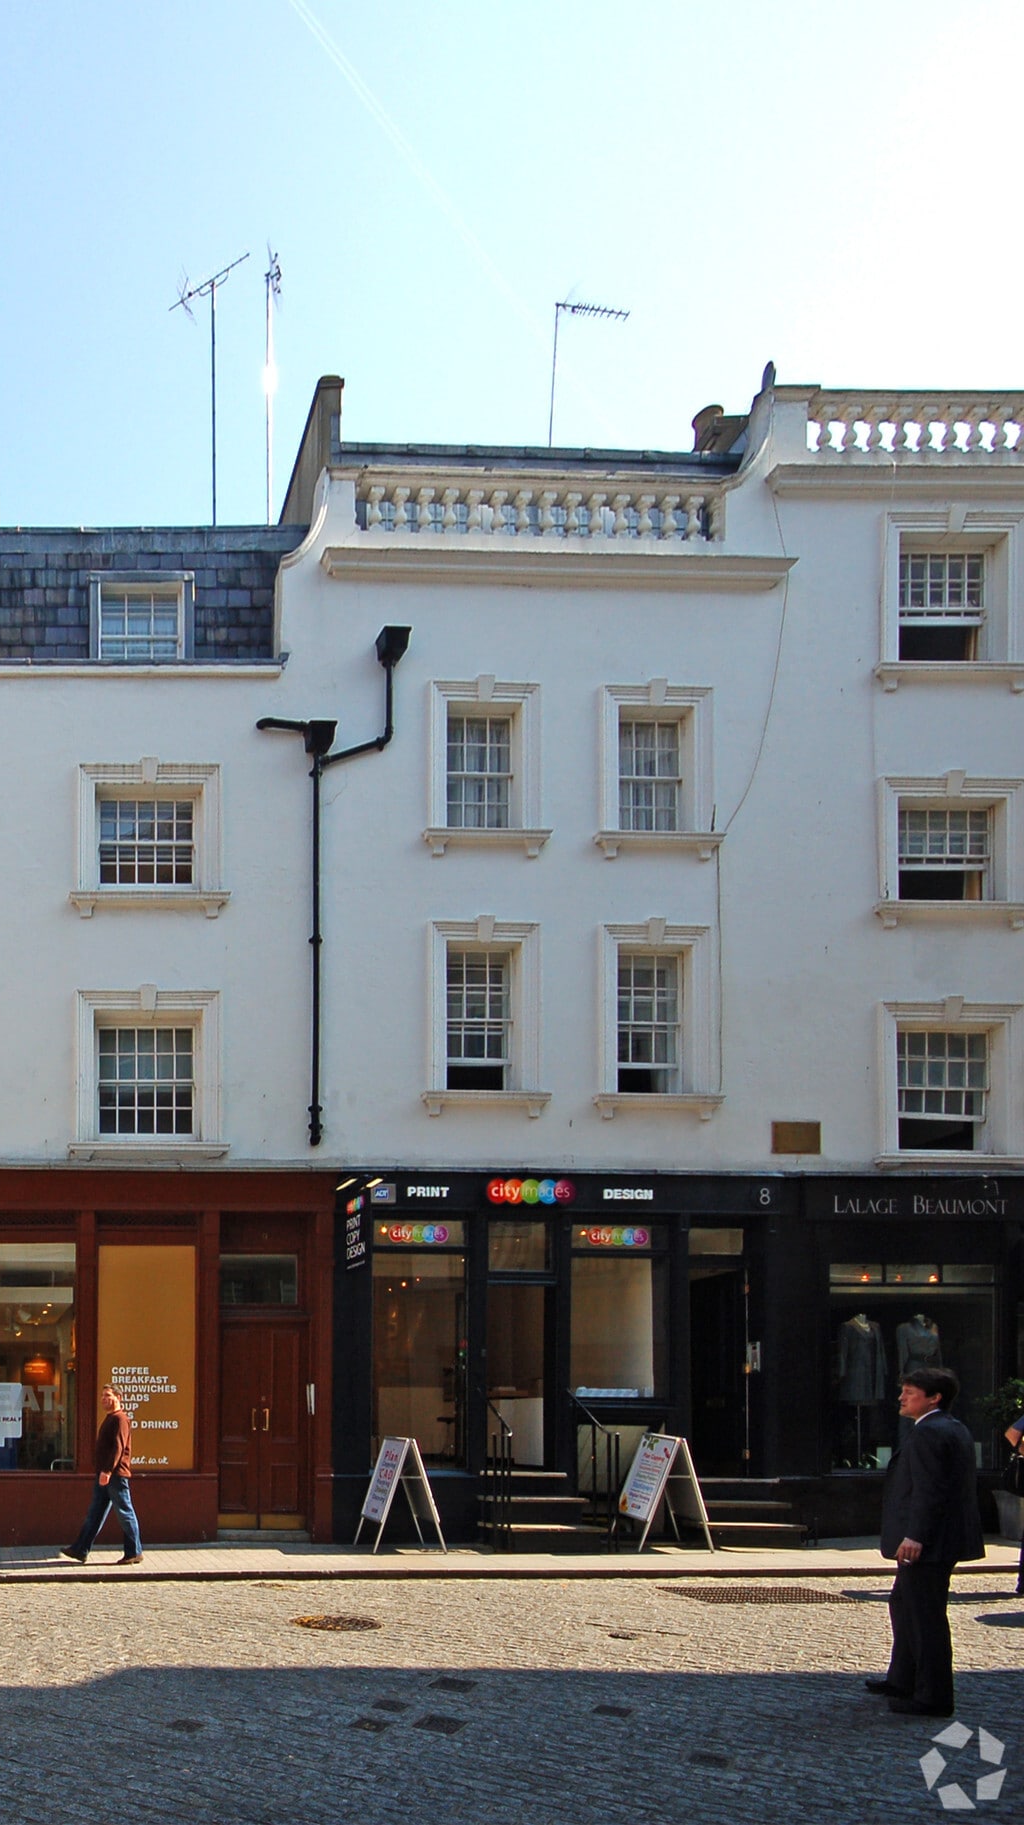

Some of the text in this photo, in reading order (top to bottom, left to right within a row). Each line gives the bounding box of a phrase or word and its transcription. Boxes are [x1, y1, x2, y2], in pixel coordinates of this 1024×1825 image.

[406, 1186, 450, 1198] PRINT
[602, 1188, 654, 1200] DESIGN
[759, 1187, 771, 1205] 8
[346, 1213, 361, 1231] PRINT
[345, 1229, 361, 1246] COPY
[346, 1241, 366, 1260] DESIGN
[111, 1366, 150, 1375] COFFEE
[111, 1376, 169, 1384] BREAKFAST
[119, 1402, 139, 1411] OUP
[140, 1420, 179, 1429] DRINKS
